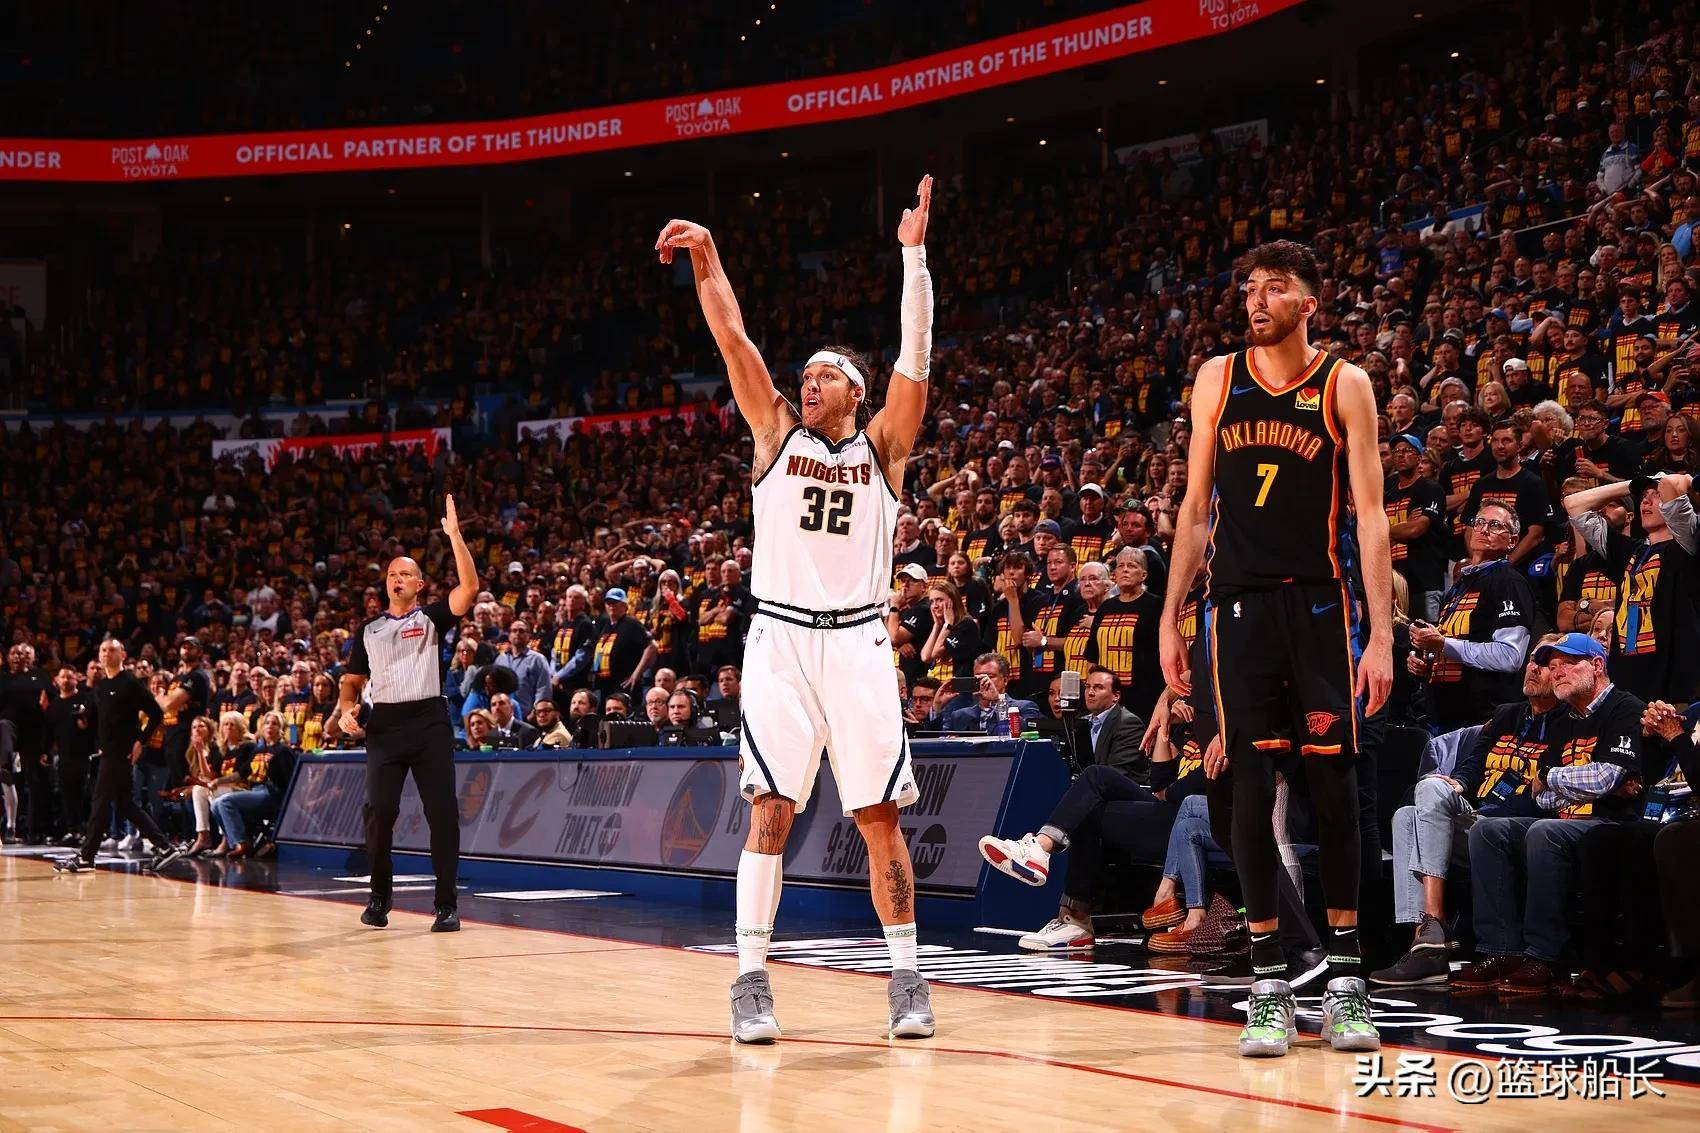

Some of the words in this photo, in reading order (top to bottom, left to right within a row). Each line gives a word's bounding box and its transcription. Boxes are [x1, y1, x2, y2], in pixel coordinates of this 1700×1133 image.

[1211, 3, 1259, 30] TOYOTA
[787, 83, 883, 112] OFFICIAL
[891, 60, 974, 96] PARTNER
[979, 52, 1005, 75] OF
[1009, 41, 1047, 69] THE
[1052, 16, 1153, 57] THUNDER
[665, 102, 696, 123] POST
[715, 97, 741, 117] OAK
[236, 143, 333, 164] OFFICIAL
[343, 136, 442, 158] PARTNER
[448, 134, 477, 152] OF
[482, 132, 521, 151] THE
[526, 118, 622, 148] THUNDER
[675, 118, 731, 136] TOYOTA
[112, 147, 143, 165] POST
[163, 144, 189, 163] OAK
[122, 164, 178, 178] TOYOTA
[1221, 420, 1324, 463] OKLAHOMA
[786, 455, 871, 486] NUGGETS
[1254, 463, 1279, 507] 7
[800, 486, 854, 536] 32
